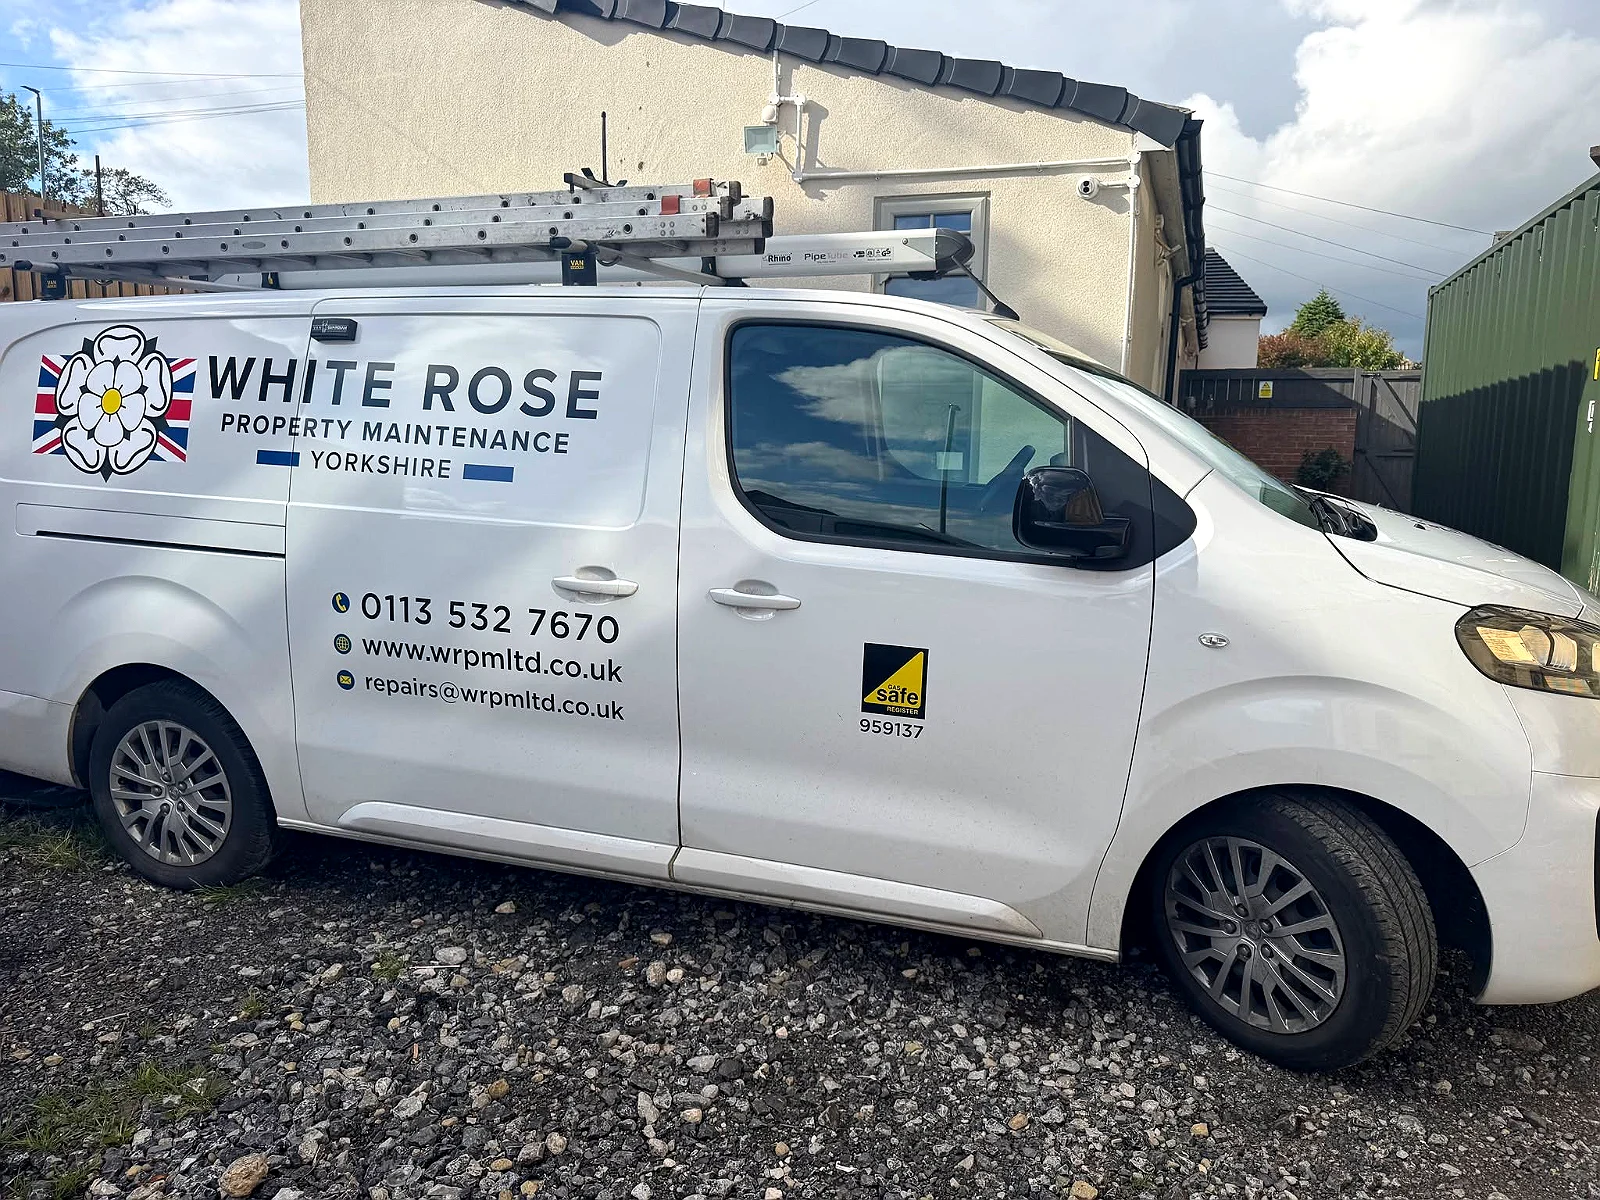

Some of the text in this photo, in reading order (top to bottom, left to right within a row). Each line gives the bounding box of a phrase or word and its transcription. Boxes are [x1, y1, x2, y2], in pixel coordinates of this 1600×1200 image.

[768, 253, 792, 262] Rhino
[208, 355, 603, 420] WHITE ROSE
[220, 413, 570, 454] PROPERTY MAINTENANCE
[310, 450, 452, 479] YORKSHIRE
[361, 592, 620, 644] 0113 532 7670
[361, 638, 623, 683] www.wrpmltd.co.uk
[365, 676, 625, 721] repairs@wrpmltd.co.uk
[877, 688, 918, 705] safe
[887, 706, 918, 715] REGISTER
[859, 718, 924, 739] 959137
